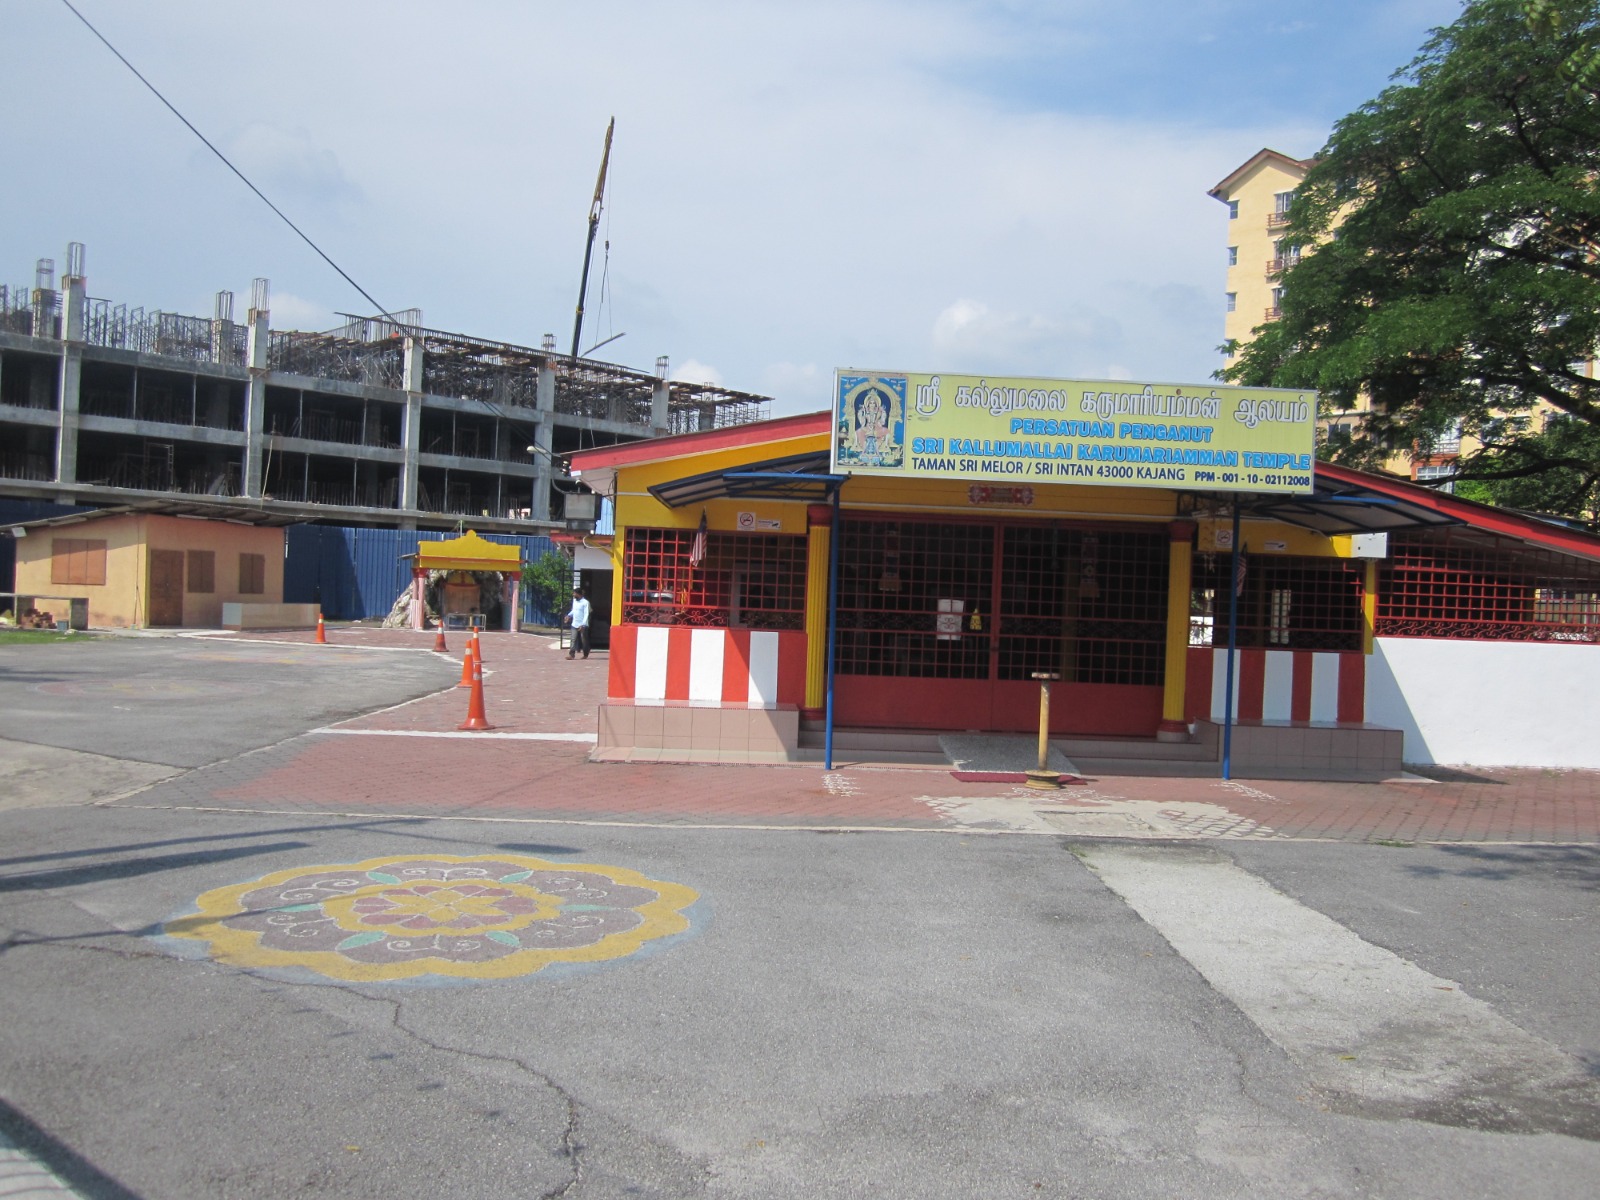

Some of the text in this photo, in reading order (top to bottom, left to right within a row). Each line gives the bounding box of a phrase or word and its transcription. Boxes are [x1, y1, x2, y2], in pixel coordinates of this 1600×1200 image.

[955, 380, 1068, 416] கல்லுமலை
[1080, 385, 1224, 420] கருமாரியம்மன்
[1233, 395, 1310, 429] ஆலயம்
[1010, 418, 1214, 443] PERSATUAN PENGANUT
[912, 437, 1311, 471] SRI KALLUMALLAI KARUMARIAMMAN TEMPLE
[911, 457, 956, 471] TAMAN
[959, 459, 978, 472] SRI
[981, 460, 1023, 474] MELOR
[1035, 461, 1053, 475] SRI
[1057, 463, 1093, 477] INTAN
[1096, 464, 1134, 479] 43000
[1136, 466, 1185, 480] KAJANG
[1194, 470, 1215, 482] PPM
[1265, 474, 1310, 486] 02112008
